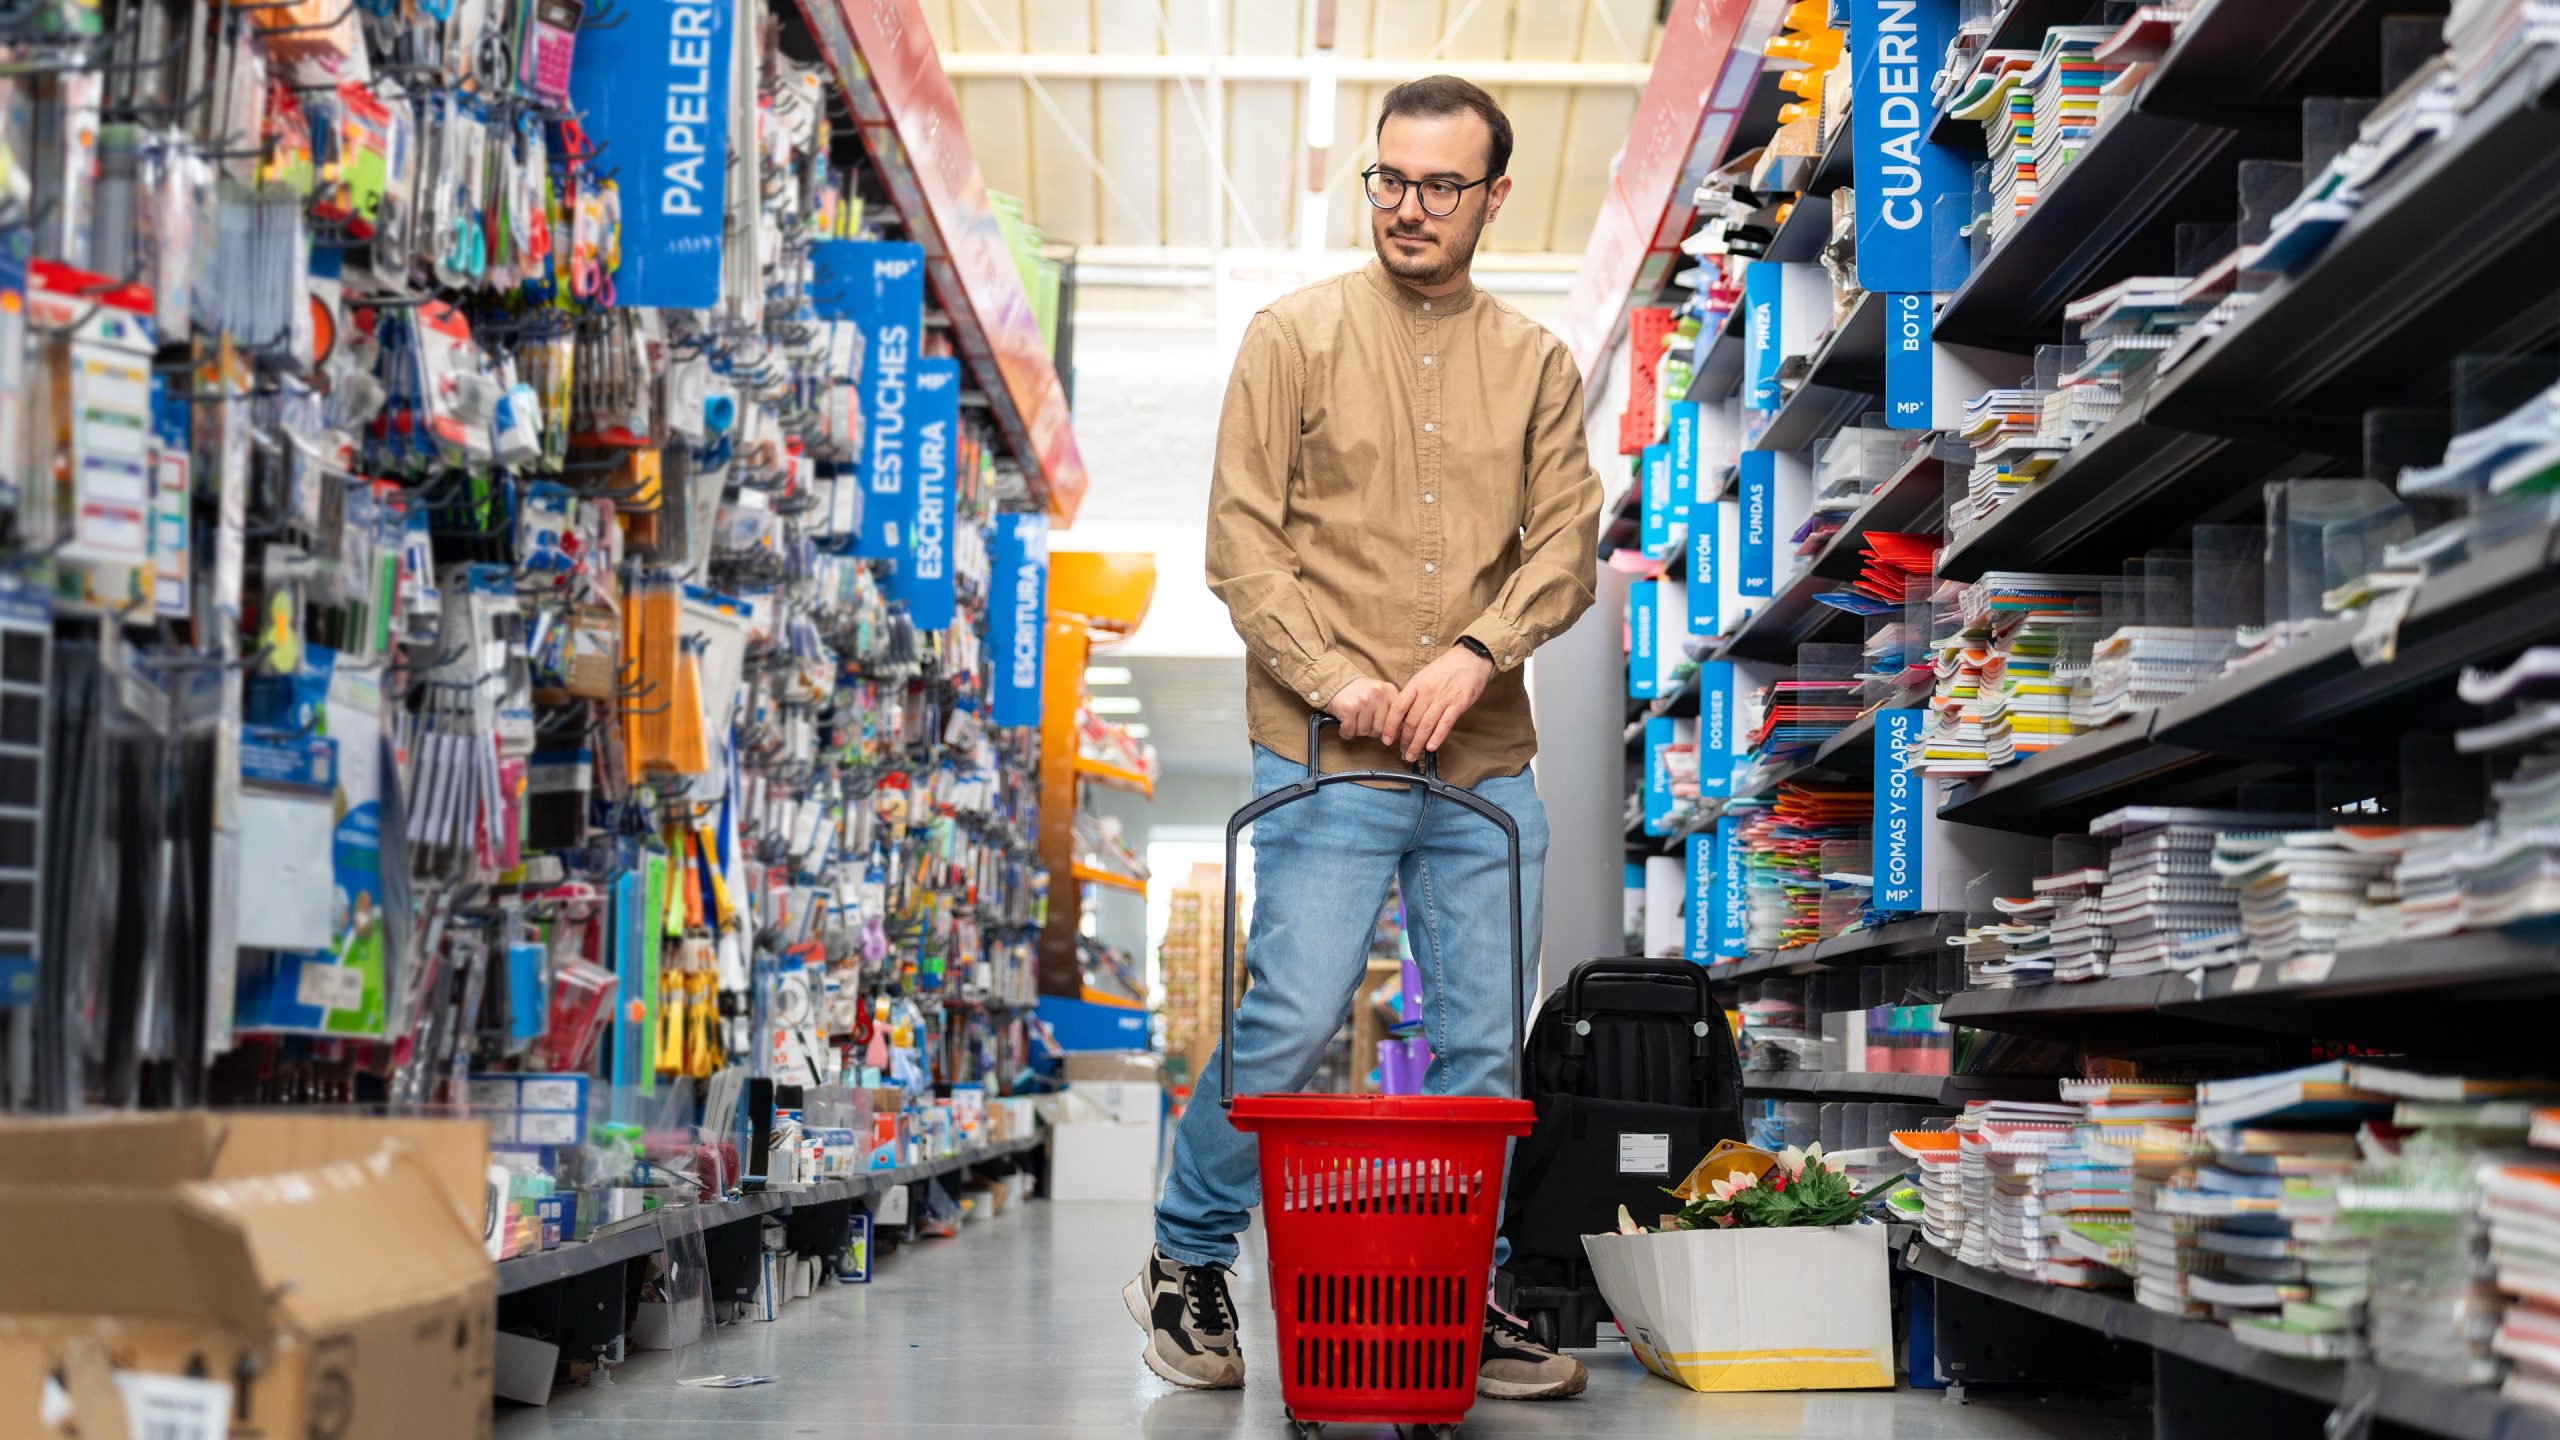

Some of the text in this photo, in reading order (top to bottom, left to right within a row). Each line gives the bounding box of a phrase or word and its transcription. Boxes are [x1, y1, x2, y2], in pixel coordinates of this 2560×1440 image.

[1878, 1, 1922, 230] CUADERN
[1756, 302, 1771, 350] PINZA
[1899, 295, 1920, 351] BOTÓ
[872, 325, 909, 494] ESTUCHES
[1897, 401, 1920, 414] MP
[1677, 417, 1691, 469] FUNDAS
[916, 421, 946, 580] ESCRITURA
[1749, 483, 1763, 545] FUNDAS
[1695, 533, 1711, 584] BOTÓN
[1013, 563, 1040, 689] ESCRITURA
[1638, 605, 1651, 658] DOSSIER
[1710, 690, 1723, 750] DOSSIER
[1890, 716, 1908, 885] GOMAS Y SOLAPAS
[1694, 838, 1710, 950] FUNDAS PLÁSTICO
[1726, 827, 1741, 929] SUBCARPETAS
[1886, 889, 1909, 901] MP
